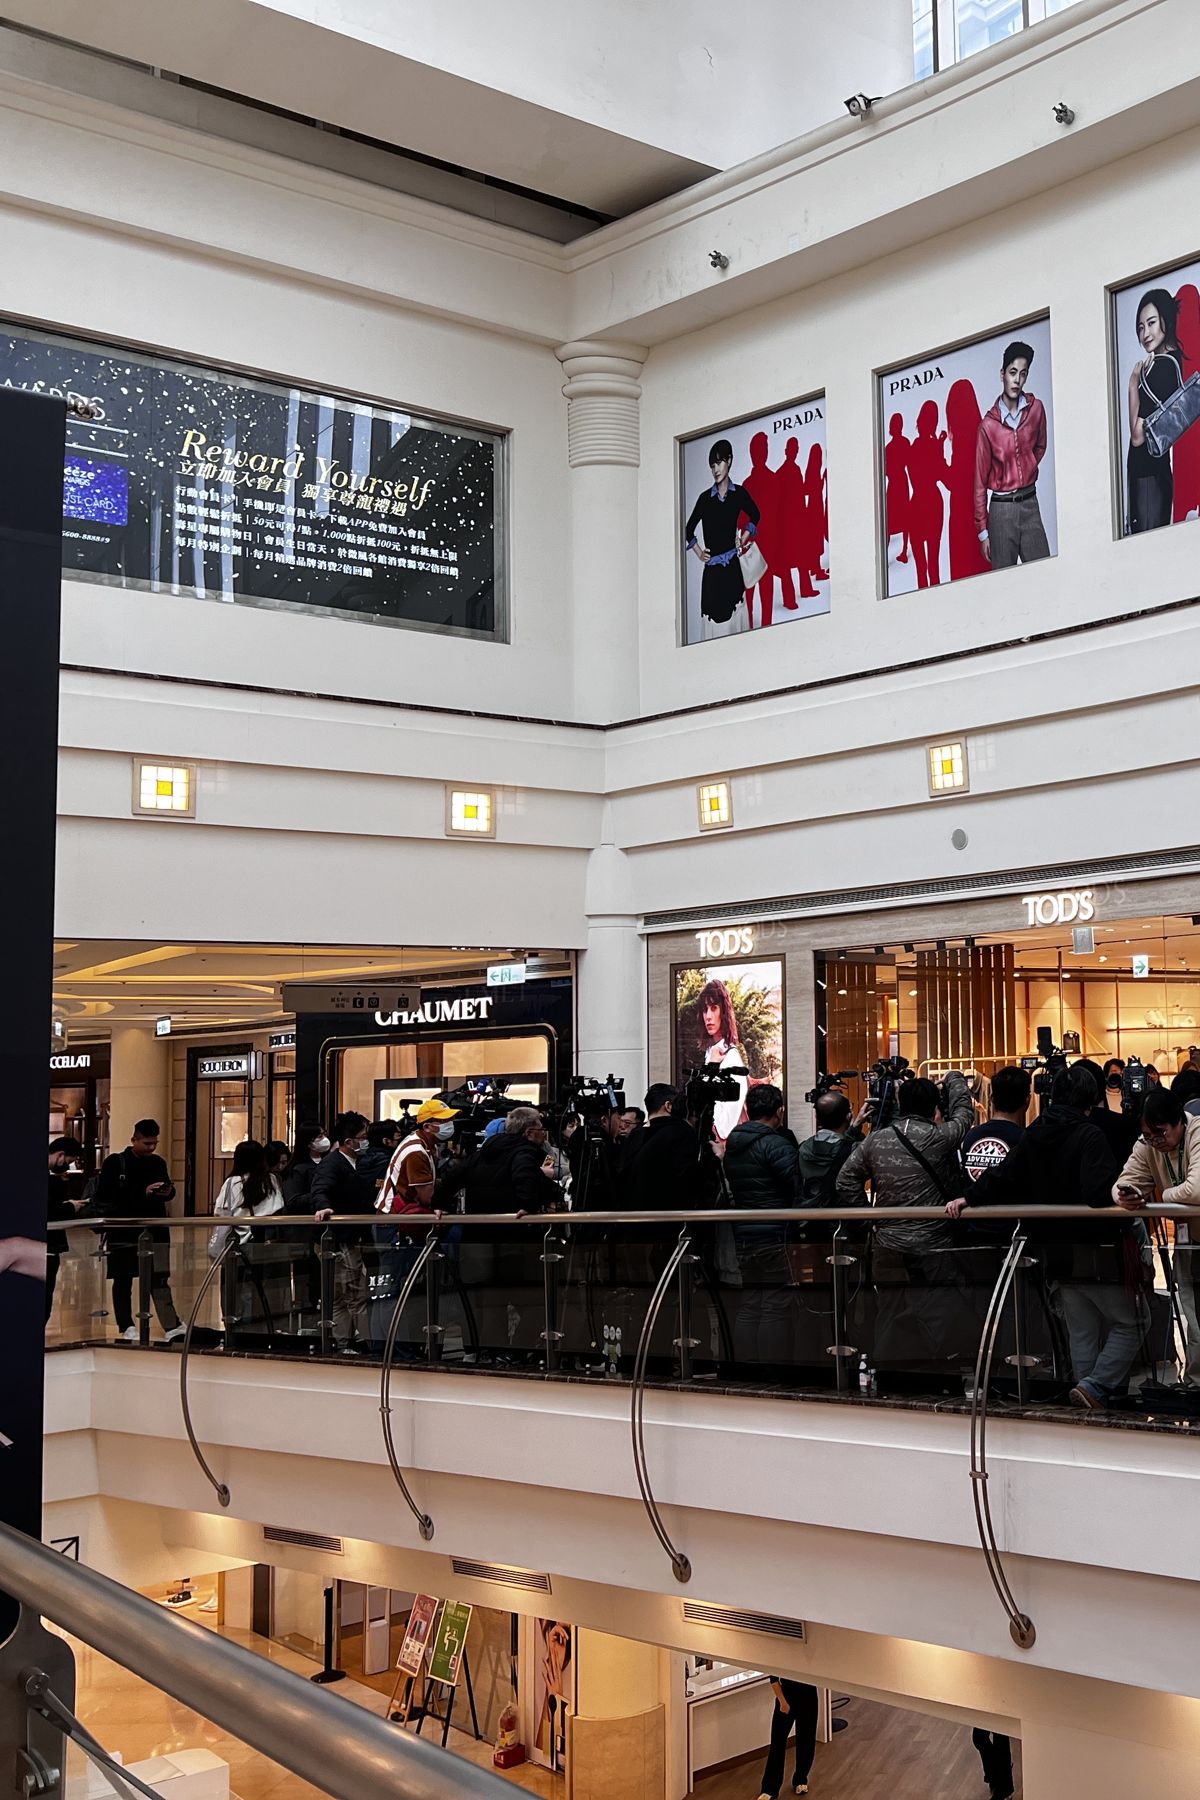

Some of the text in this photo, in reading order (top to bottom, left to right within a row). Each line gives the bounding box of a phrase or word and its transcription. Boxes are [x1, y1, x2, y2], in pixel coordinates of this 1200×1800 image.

[890, 367, 944, 396] PRADA
[773, 407, 823, 434] PRADA
[176, 459, 291, 495] 立即加入會員
[178, 429, 436, 511] Reward Yourself
[1022, 890, 1095, 925] TOD'S
[695, 928, 754, 958] TOD'S
[50, 1054, 91, 1069] CCELLATI
